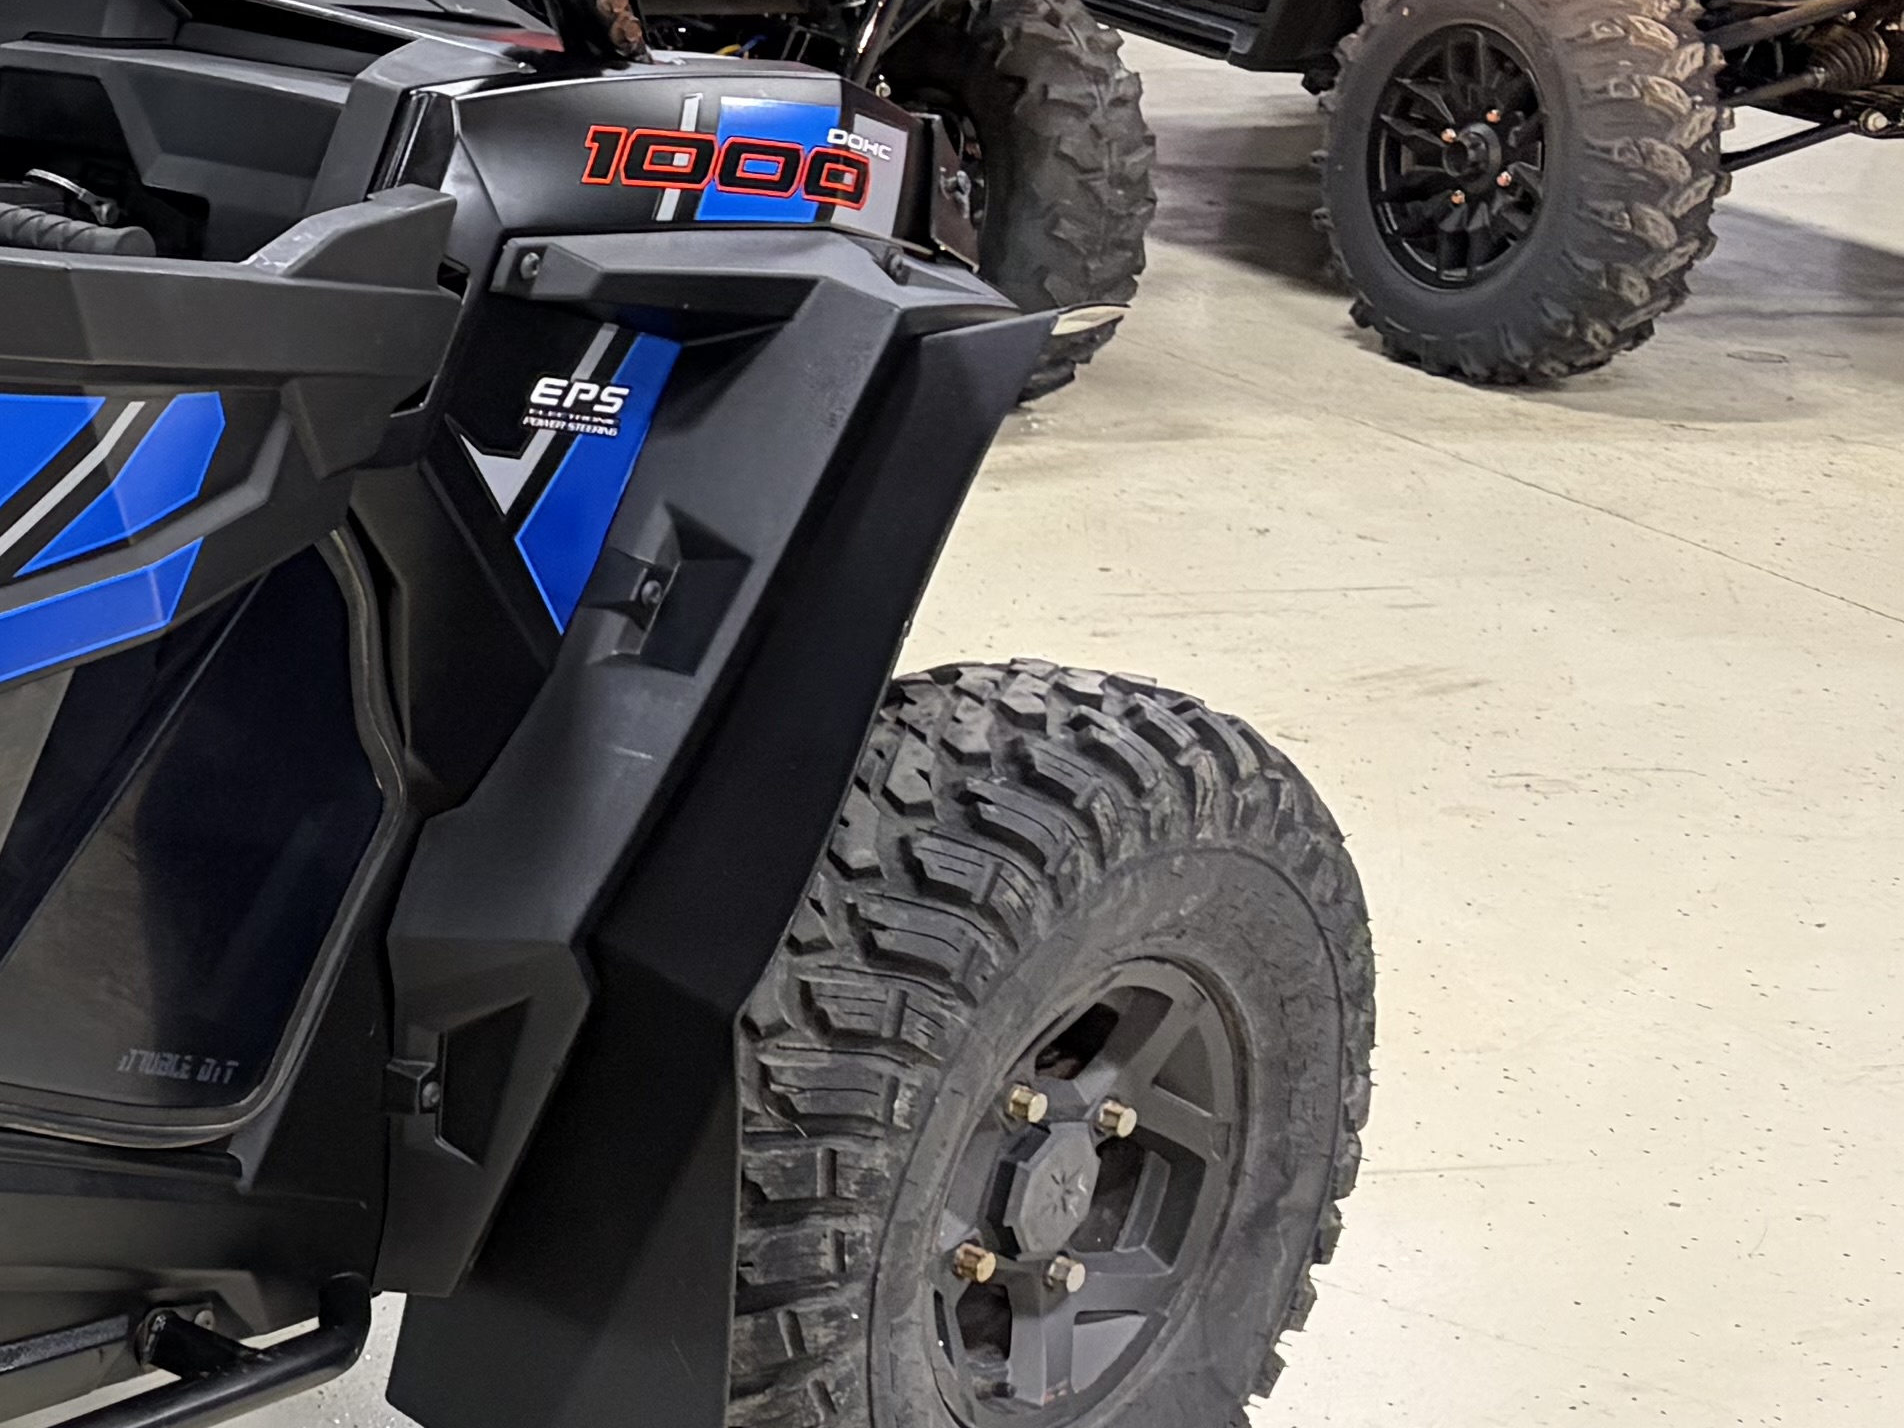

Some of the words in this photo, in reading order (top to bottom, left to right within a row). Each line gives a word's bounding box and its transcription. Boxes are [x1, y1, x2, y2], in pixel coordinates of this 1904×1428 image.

[827, 128, 892, 160] DOHC
[581, 125, 871, 211] 1000
[530, 376, 630, 414] EPS
[522, 416, 566, 431] POWER
[566, 422, 618, 437] STEERING
